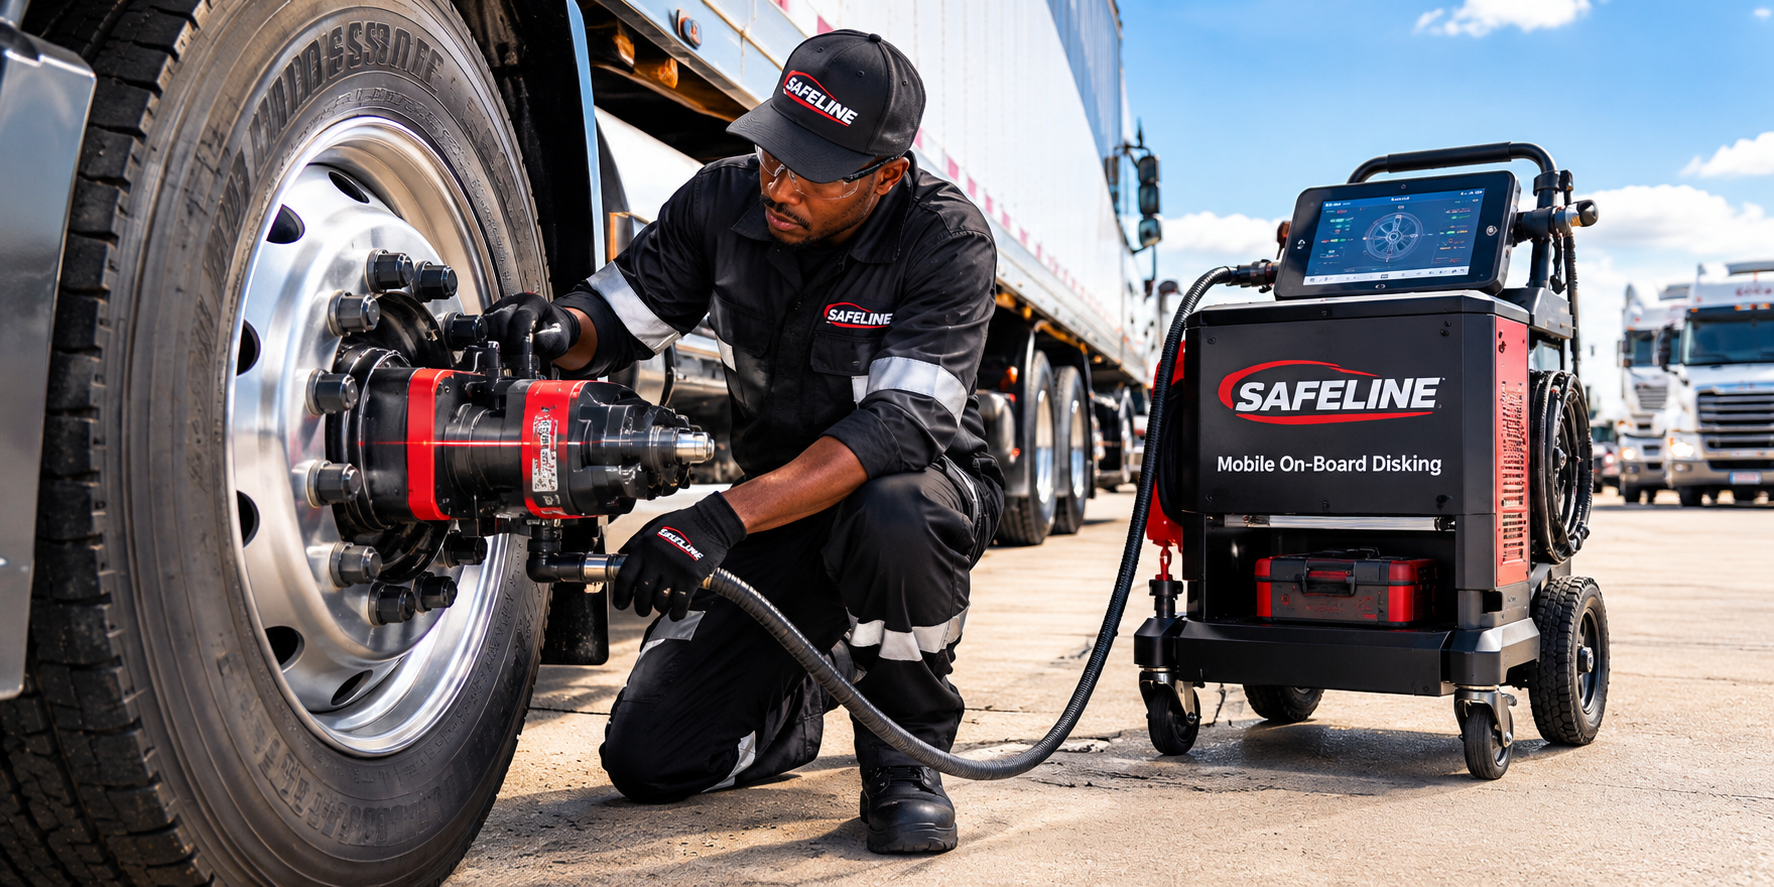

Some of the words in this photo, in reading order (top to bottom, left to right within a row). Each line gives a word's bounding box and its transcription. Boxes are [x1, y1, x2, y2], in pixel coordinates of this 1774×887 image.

[785, 77, 858, 125] SAFELINE
[827, 308, 893, 326] SAFELINE
[1235, 377, 1441, 412] SAFELINE
[1217, 455, 1275, 472] Mobile
[1279, 455, 1367, 472] On-Board
[1372, 454, 1442, 476] Disking
